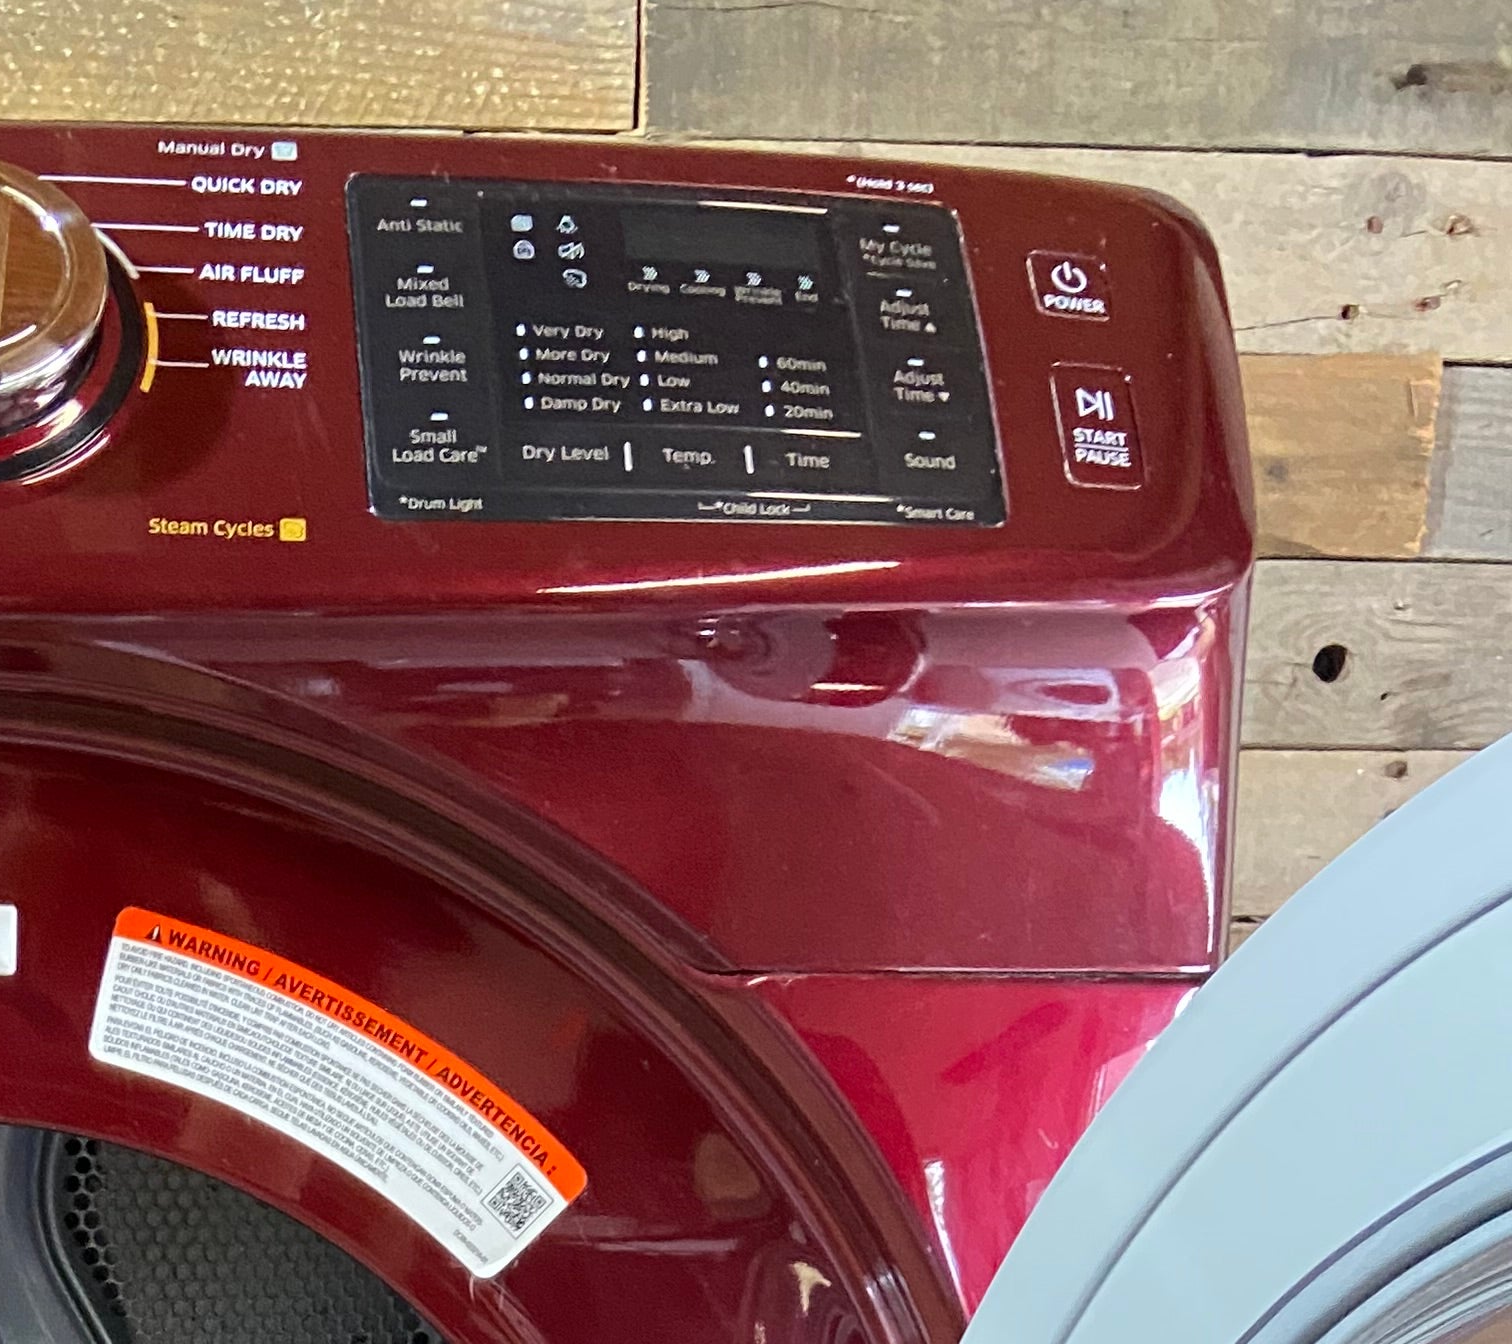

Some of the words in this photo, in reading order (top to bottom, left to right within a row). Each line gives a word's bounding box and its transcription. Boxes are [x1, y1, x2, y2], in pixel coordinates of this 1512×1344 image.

[157, 140, 225, 157] Manual
[230, 142, 265, 161] Dry
[191, 177, 256, 195] QUICK
[260, 178, 303, 197] DRY
[204, 221, 256, 240] TIME
[260, 224, 304, 243] DRY
[377, 217, 414, 233] Anti
[417, 218, 464, 234] Static
[889, 240, 933, 256] Cycle
[199, 264, 237, 282] AIR
[240, 265, 305, 285] FLUFF
[397, 277, 450, 292] Mixed
[386, 294, 429, 308] Load
[433, 295, 464, 309] Bell
[879, 299, 931, 317] Adjust
[1043, 294, 1106, 314] POWER
[212, 311, 306, 332] REFRESH
[879, 315, 922, 332] Time
[532, 324, 570, 340] Very
[574, 325, 605, 341] Dry
[651, 326, 689, 342] High
[211, 349, 308, 370] WRINKLE
[398, 350, 467, 365] Wrinkle
[535, 349, 577, 363] More
[580, 350, 611, 365] Dry
[654, 350, 720, 366] Medium
[775, 356, 828, 373] 60min
[244, 369, 308, 390] AWAY
[399, 368, 469, 383] Prevent
[538, 372, 597, 387] Normal
[600, 373, 631, 389] Dry
[657, 374, 691, 389] Low
[893, 369, 946, 387] Adjust
[780, 380, 832, 397] 40min
[892, 386, 936, 403] Time
[540, 397, 588, 413] Damp
[591, 397, 622, 414] Dry
[660, 399, 703, 414] Extra
[707, 400, 740, 415] Low
[783, 404, 835, 421] 20min
[409, 428, 458, 444] Small
[1072, 427, 1128, 447] START
[392, 448, 435, 463] Load
[522, 446, 557, 462] Dry
[560, 446, 610, 462] Level
[662, 447, 717, 467] Temp.
[785, 452, 831, 469] Time
[903, 452, 957, 470] Sound
[1074, 447, 1132, 468] PAUSE
[449, 497, 484, 513] Light
[759, 502, 791, 517] Lock
[945, 507, 976, 521] Care
[148, 517, 209, 536] Steam
[213, 519, 275, 540] Cycles
[169, 928, 262, 976] WARNING
[274, 973, 429, 1065] AVERTISSEMENT
[436, 1066, 549, 1168] ADVERTENCIA
